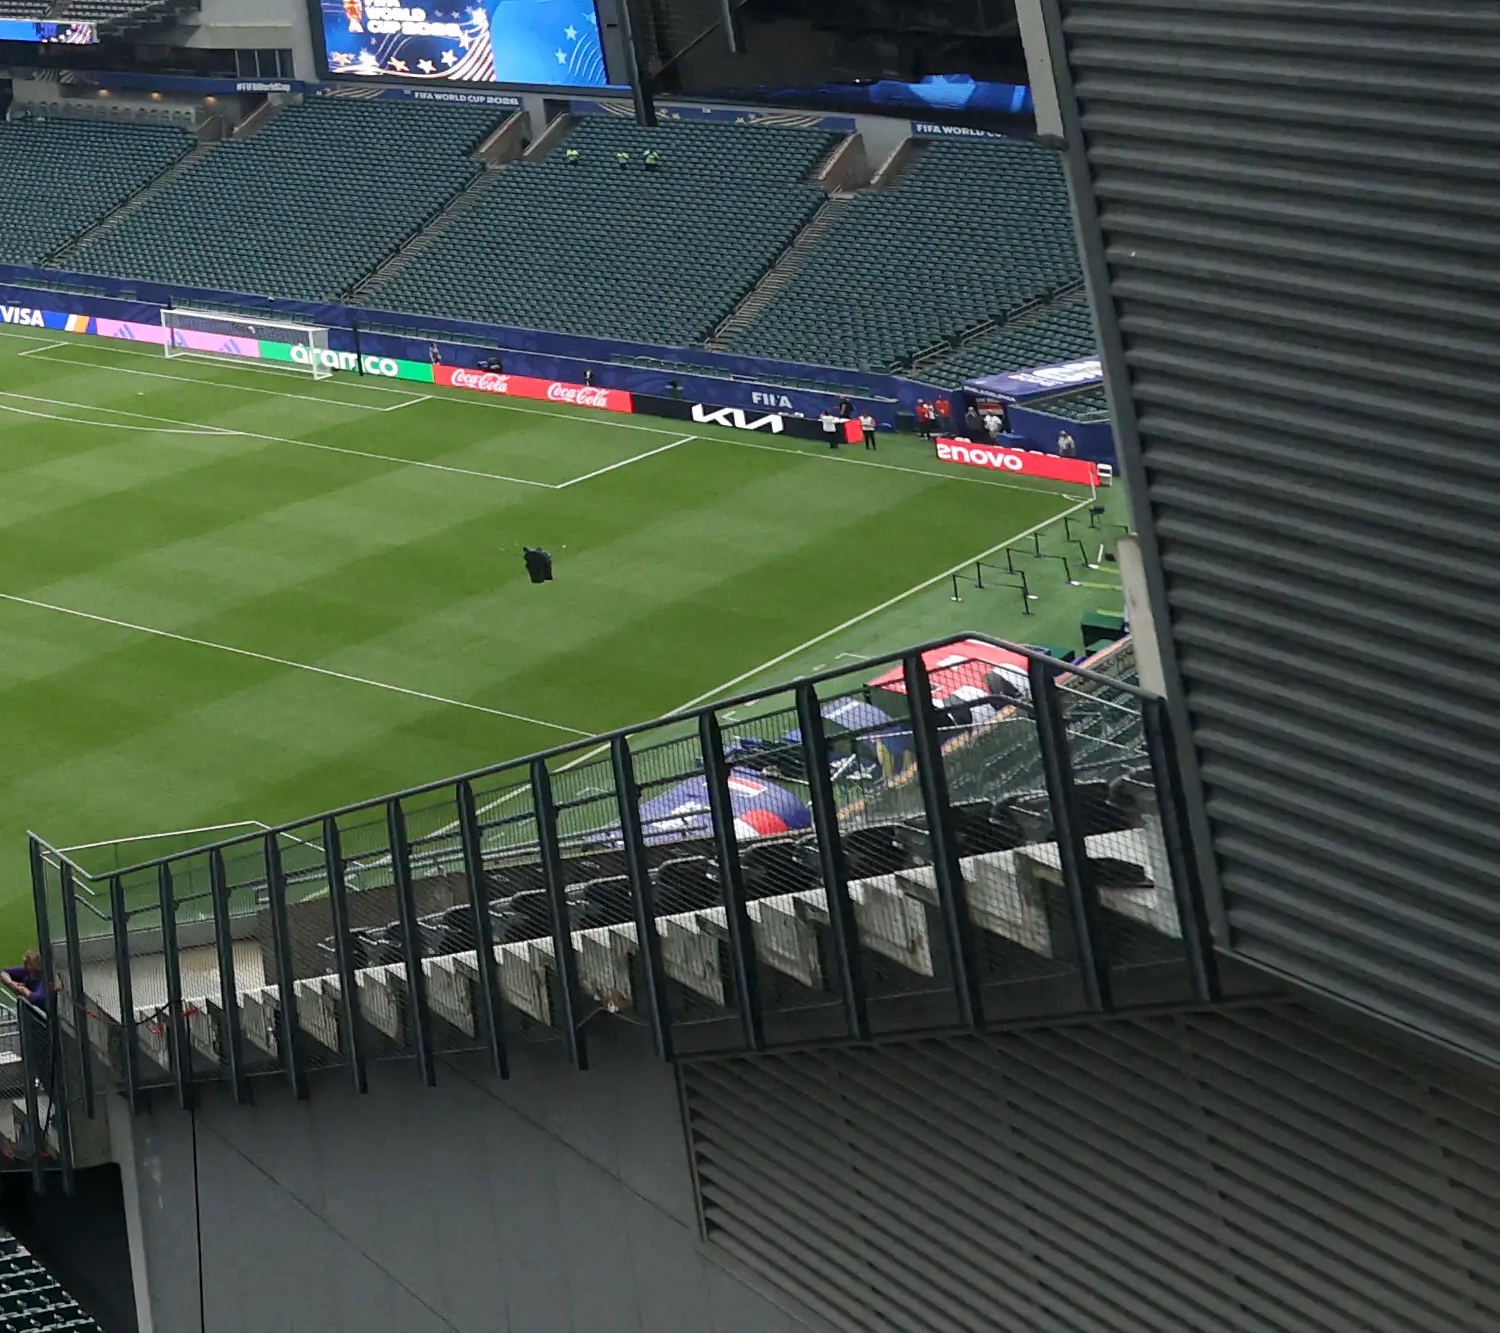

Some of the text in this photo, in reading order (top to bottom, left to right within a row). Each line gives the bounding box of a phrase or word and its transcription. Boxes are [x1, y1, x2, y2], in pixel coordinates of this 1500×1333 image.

[364, 6, 426, 21] WORLD
[414, 92, 434, 100] FIFA
[434, 93, 467, 102] WORLD
[467, 95, 485, 103] CUP
[915, 124, 942, 134] FIFA
[290, 345, 399, 377] aramco
[451, 368, 509, 393] Coca-Cola
[547, 382, 609, 407] Coca-Cola
